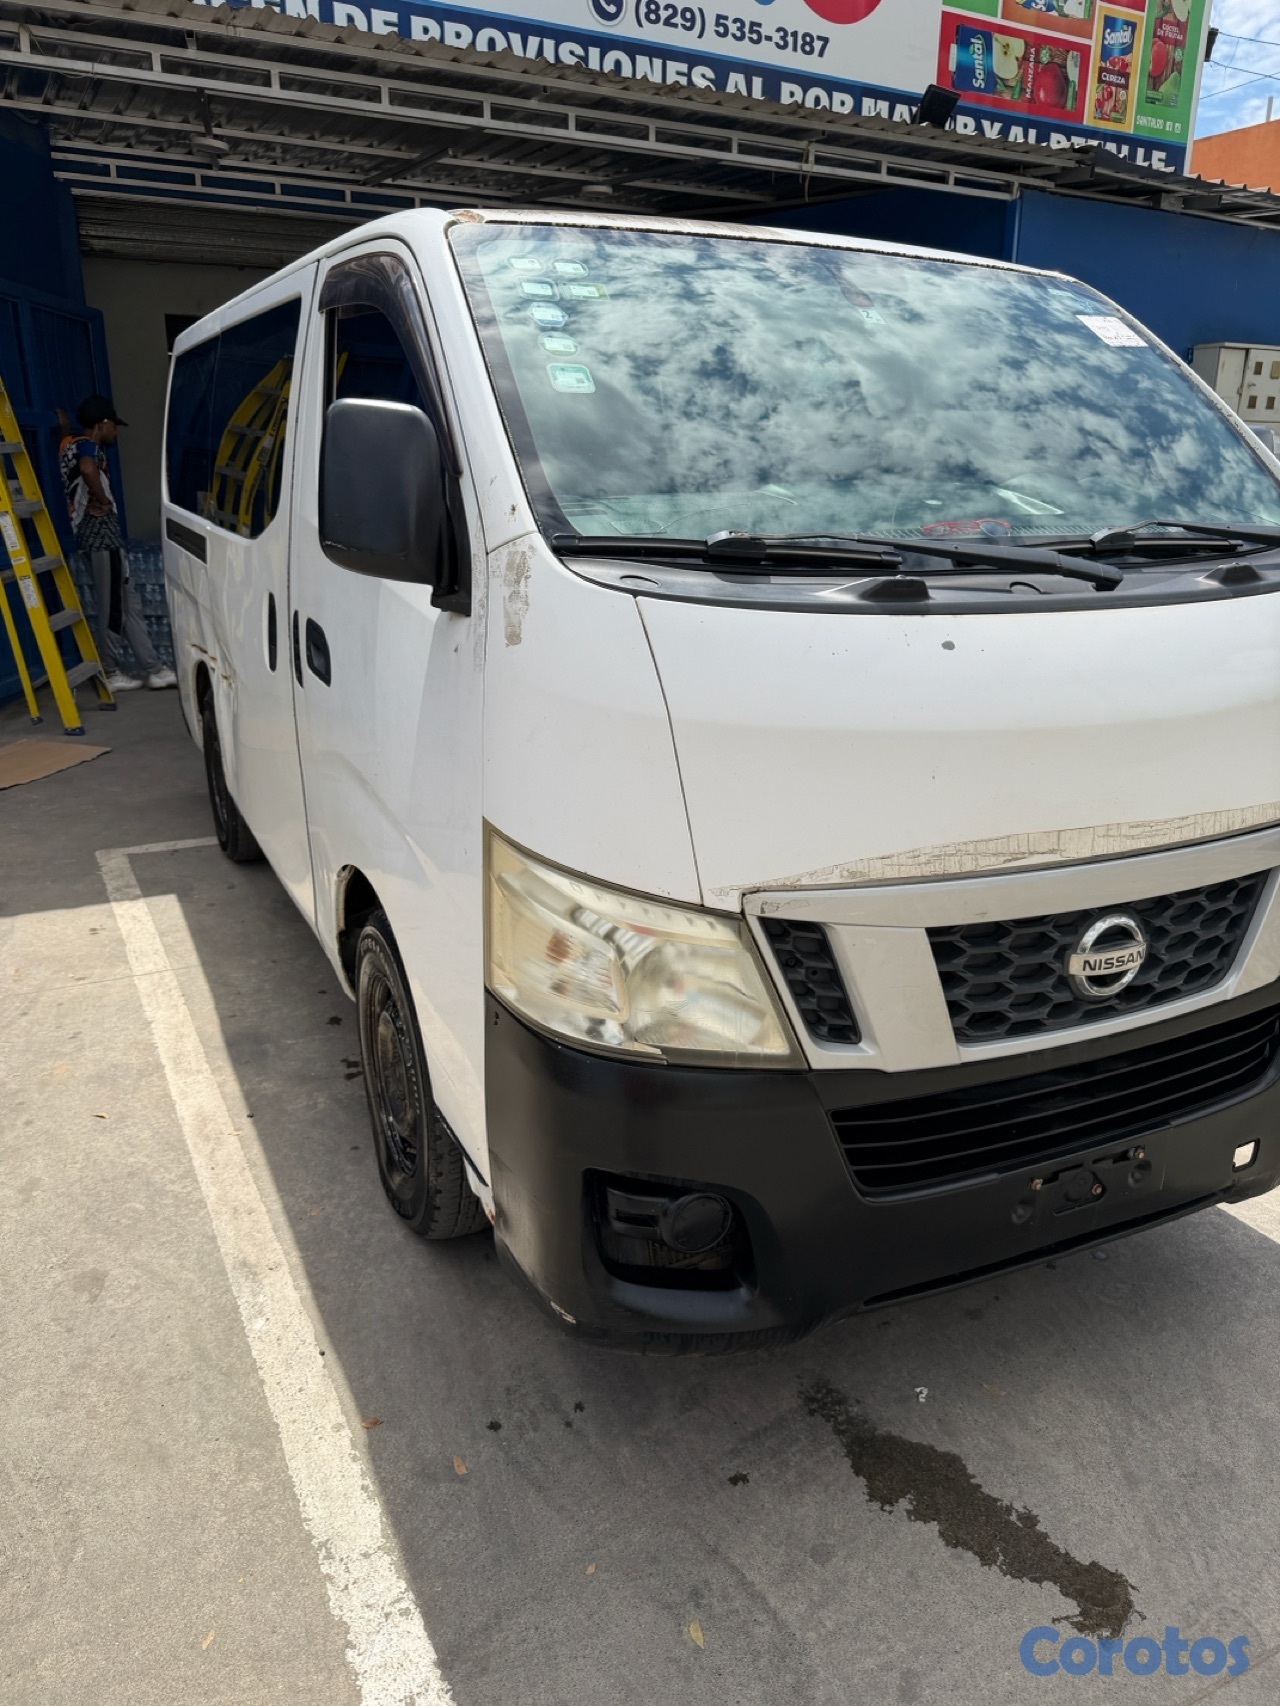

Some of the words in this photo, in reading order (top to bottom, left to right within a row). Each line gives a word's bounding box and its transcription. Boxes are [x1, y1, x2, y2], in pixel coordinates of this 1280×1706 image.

[634, 0, 706, 39] (829)
[714, 13, 830, 58] 535-3187
[1103, 25, 1133, 45] Santal
[410, 14, 717, 92] PROVISIONES
[861, 96, 976, 136] MAR
[972, 38, 986, 89] Santal
[1025, 47, 1036, 99] MANZANA
[1101, 72, 1126, 85] CEREZA
[1082, 950, 1146, 972] NISSAN
